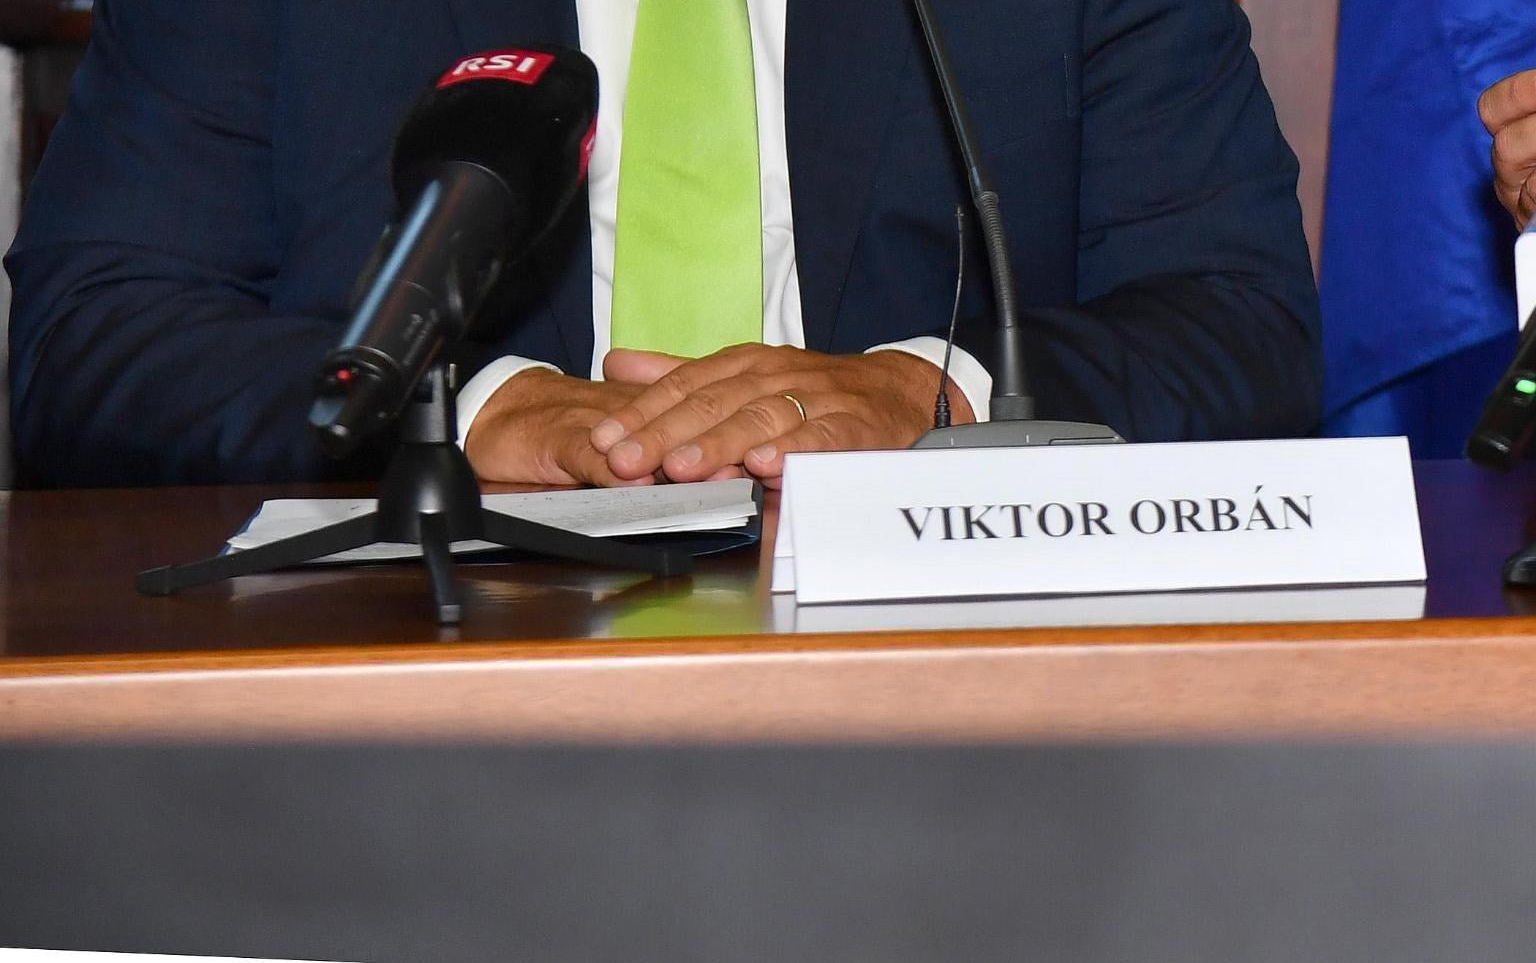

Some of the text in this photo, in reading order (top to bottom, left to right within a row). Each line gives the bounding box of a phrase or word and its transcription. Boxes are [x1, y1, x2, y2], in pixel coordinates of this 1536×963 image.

[452, 54, 536, 75] RSI
[898, 485, 1314, 542] VIKTOR ORBÁN
